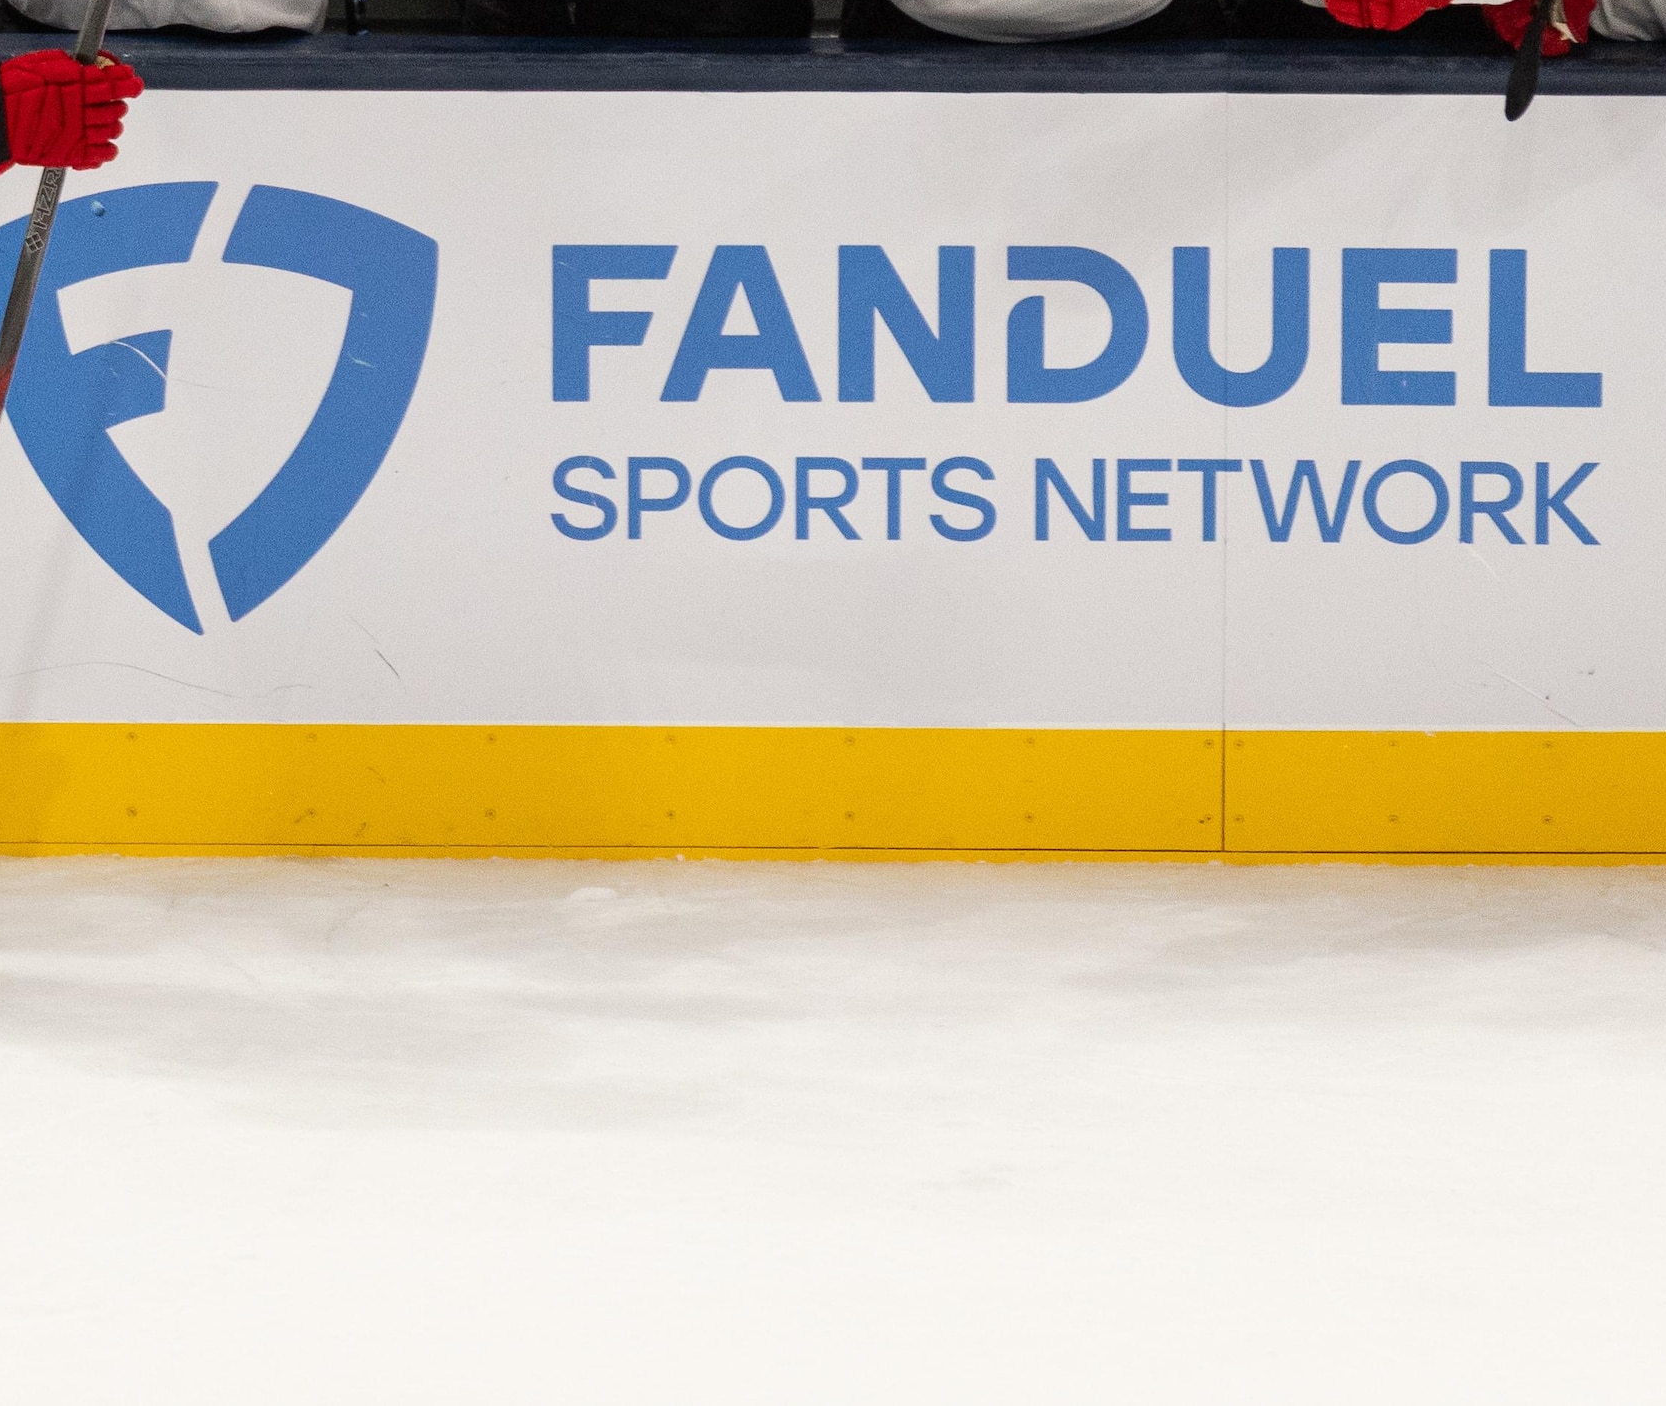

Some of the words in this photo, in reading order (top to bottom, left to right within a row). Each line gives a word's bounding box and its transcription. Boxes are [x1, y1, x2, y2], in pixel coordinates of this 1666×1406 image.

[551, 243, 1604, 409] FANDUEL
[550, 454, 998, 543] SPORTS
[1033, 458, 1603, 546] NETWORK
